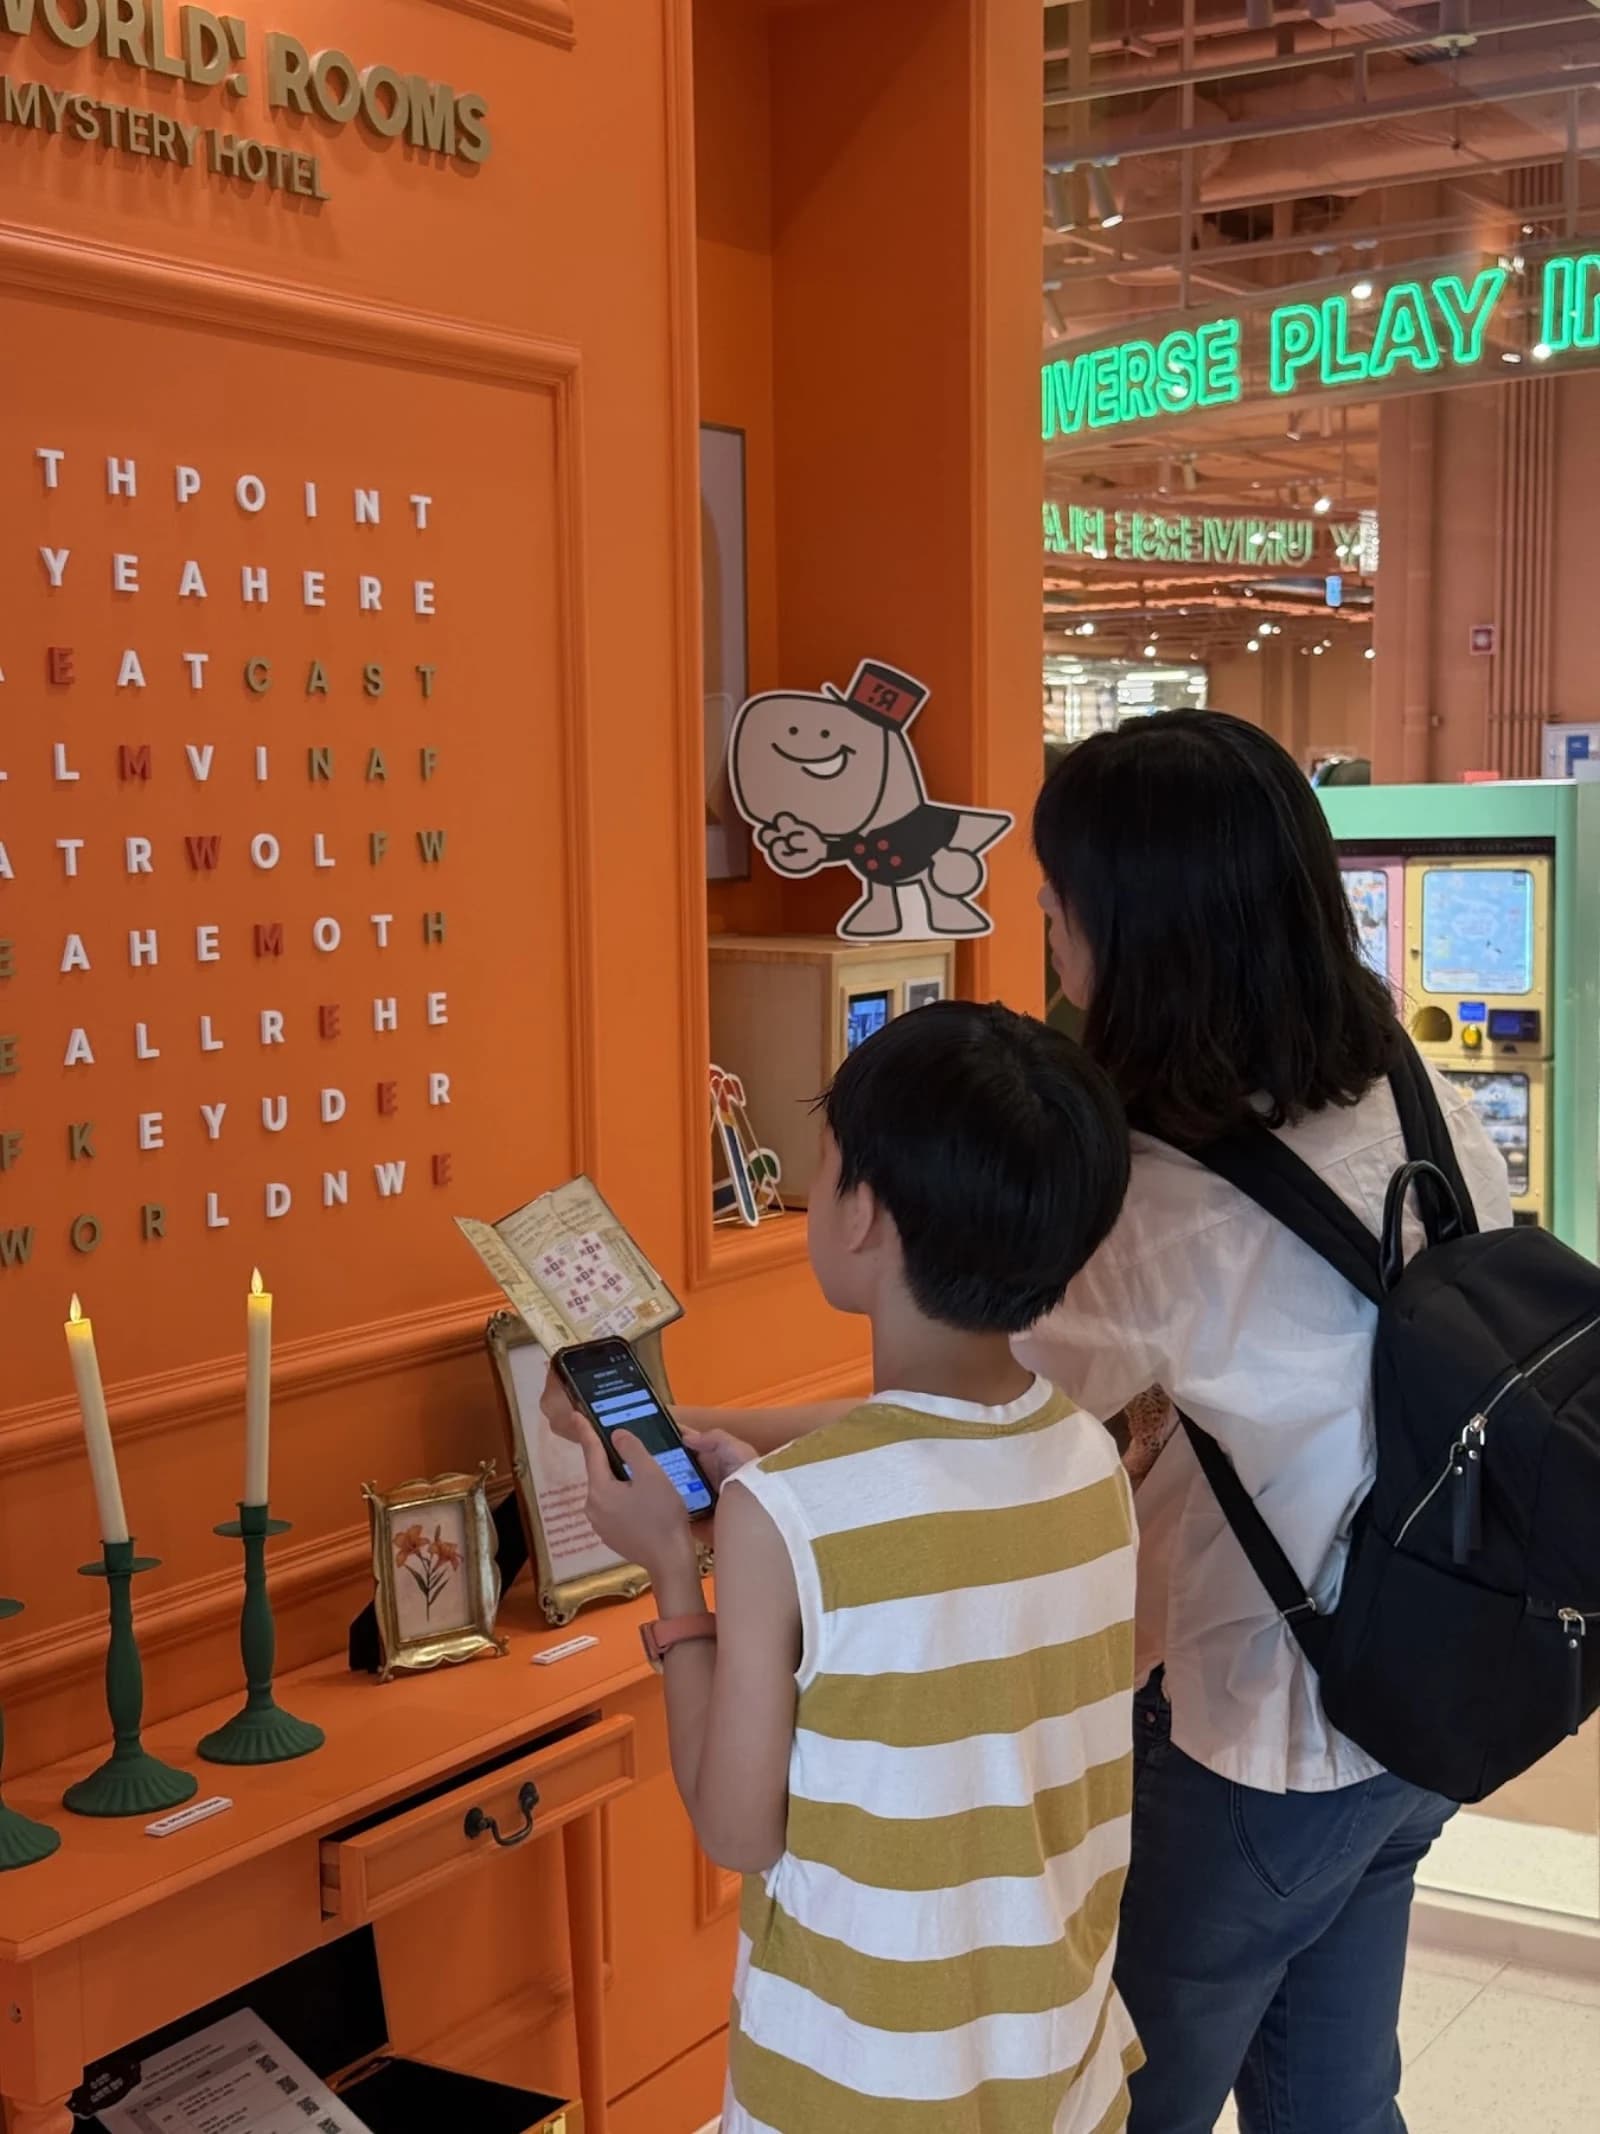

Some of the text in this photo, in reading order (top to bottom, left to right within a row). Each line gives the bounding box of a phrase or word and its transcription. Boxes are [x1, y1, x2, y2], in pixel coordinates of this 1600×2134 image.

[2, 74, 332, 201] MYSTERY HOTEL
[265, 31, 491, 164] ROOMS
[1270, 267, 1507, 393] PLAY
